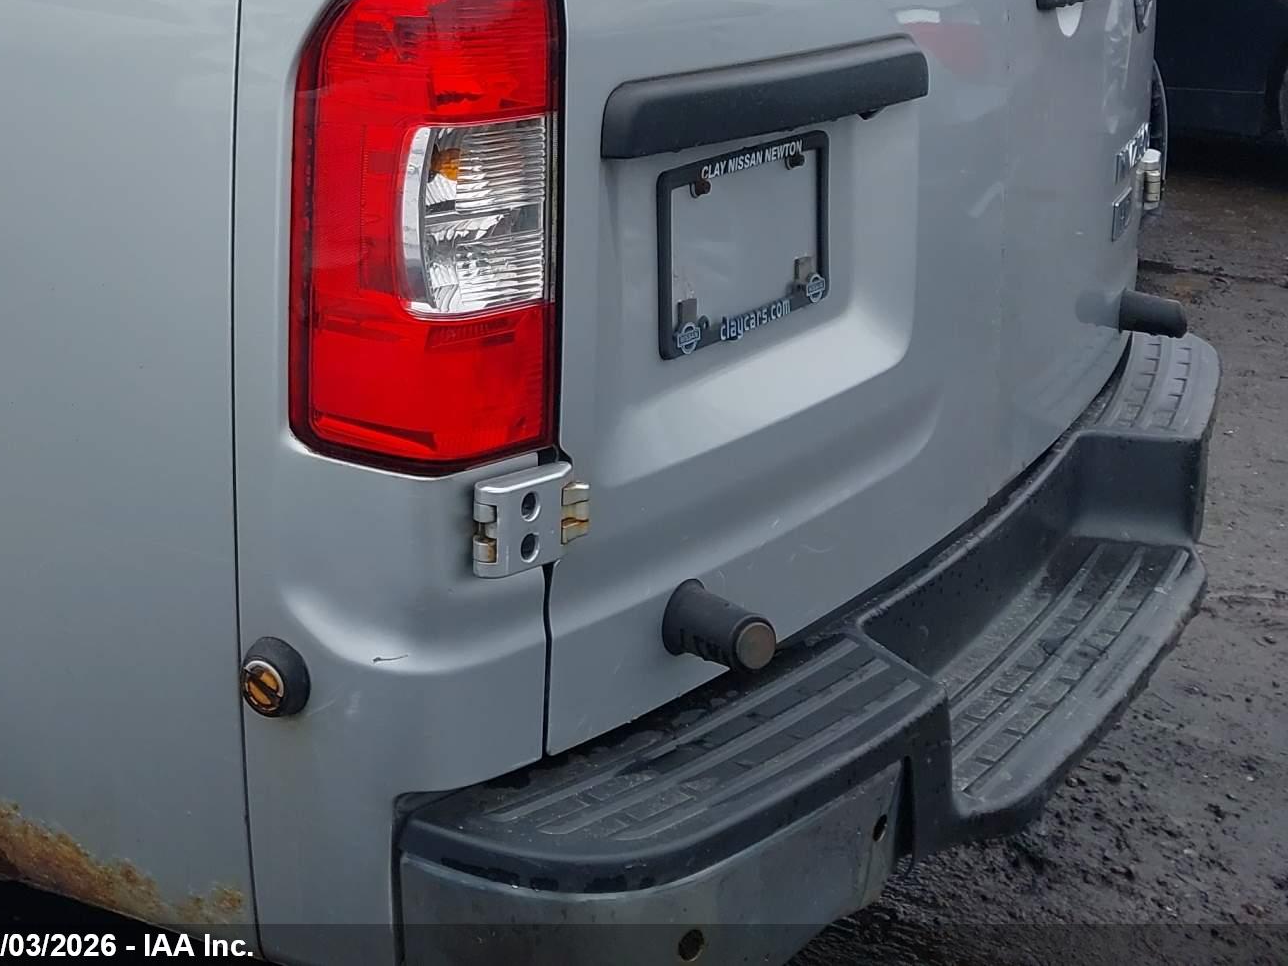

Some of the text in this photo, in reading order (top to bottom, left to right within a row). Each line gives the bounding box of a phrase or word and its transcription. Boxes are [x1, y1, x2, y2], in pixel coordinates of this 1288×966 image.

[701, 139, 803, 179] CLAY NISSAN NEWTON
[720, 298, 791, 341] claycars.com
